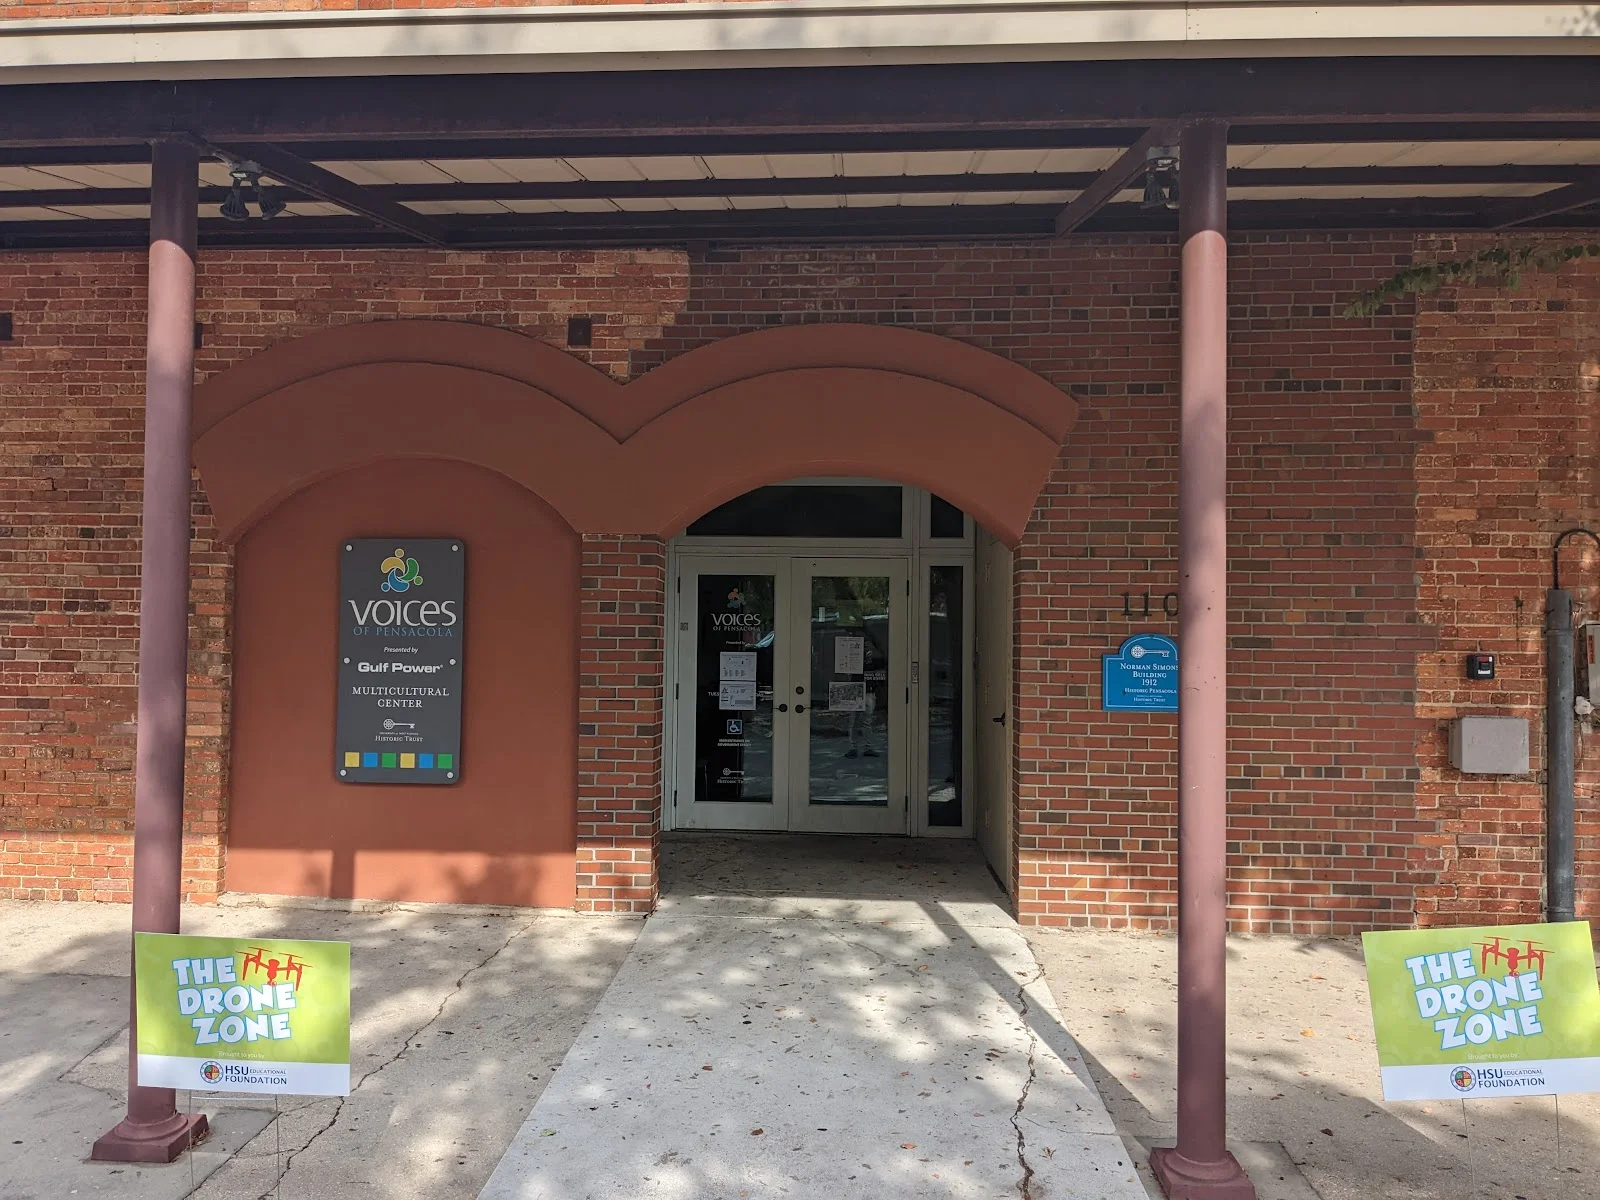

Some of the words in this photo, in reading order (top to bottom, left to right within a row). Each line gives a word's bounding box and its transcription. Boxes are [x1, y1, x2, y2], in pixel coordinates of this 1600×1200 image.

[353, 626, 370, 636] OF
[376, 627, 453, 637] PENSACOLA
[357, 662, 389, 673] Gulf
[351, 686, 450, 696] MULTICULTURAL
[377, 698, 423, 708] CENTER
[172, 956, 237, 986] THE
[1404, 948, 1478, 987] THE
[177, 982, 297, 1016] DRONE
[1414, 970, 1544, 1019] DRONE
[192, 1012, 293, 1046] ZONE
[1433, 1004, 1544, 1051] ZONE
[1467, 1053, 1491, 1062] Brought
[225, 1065, 249, 1076] HSU
[1477, 1068, 1503, 1079] HSU
[225, 1075, 287, 1085] FOUNDATION
[1478, 1077, 1545, 1089] FOUNDATION
